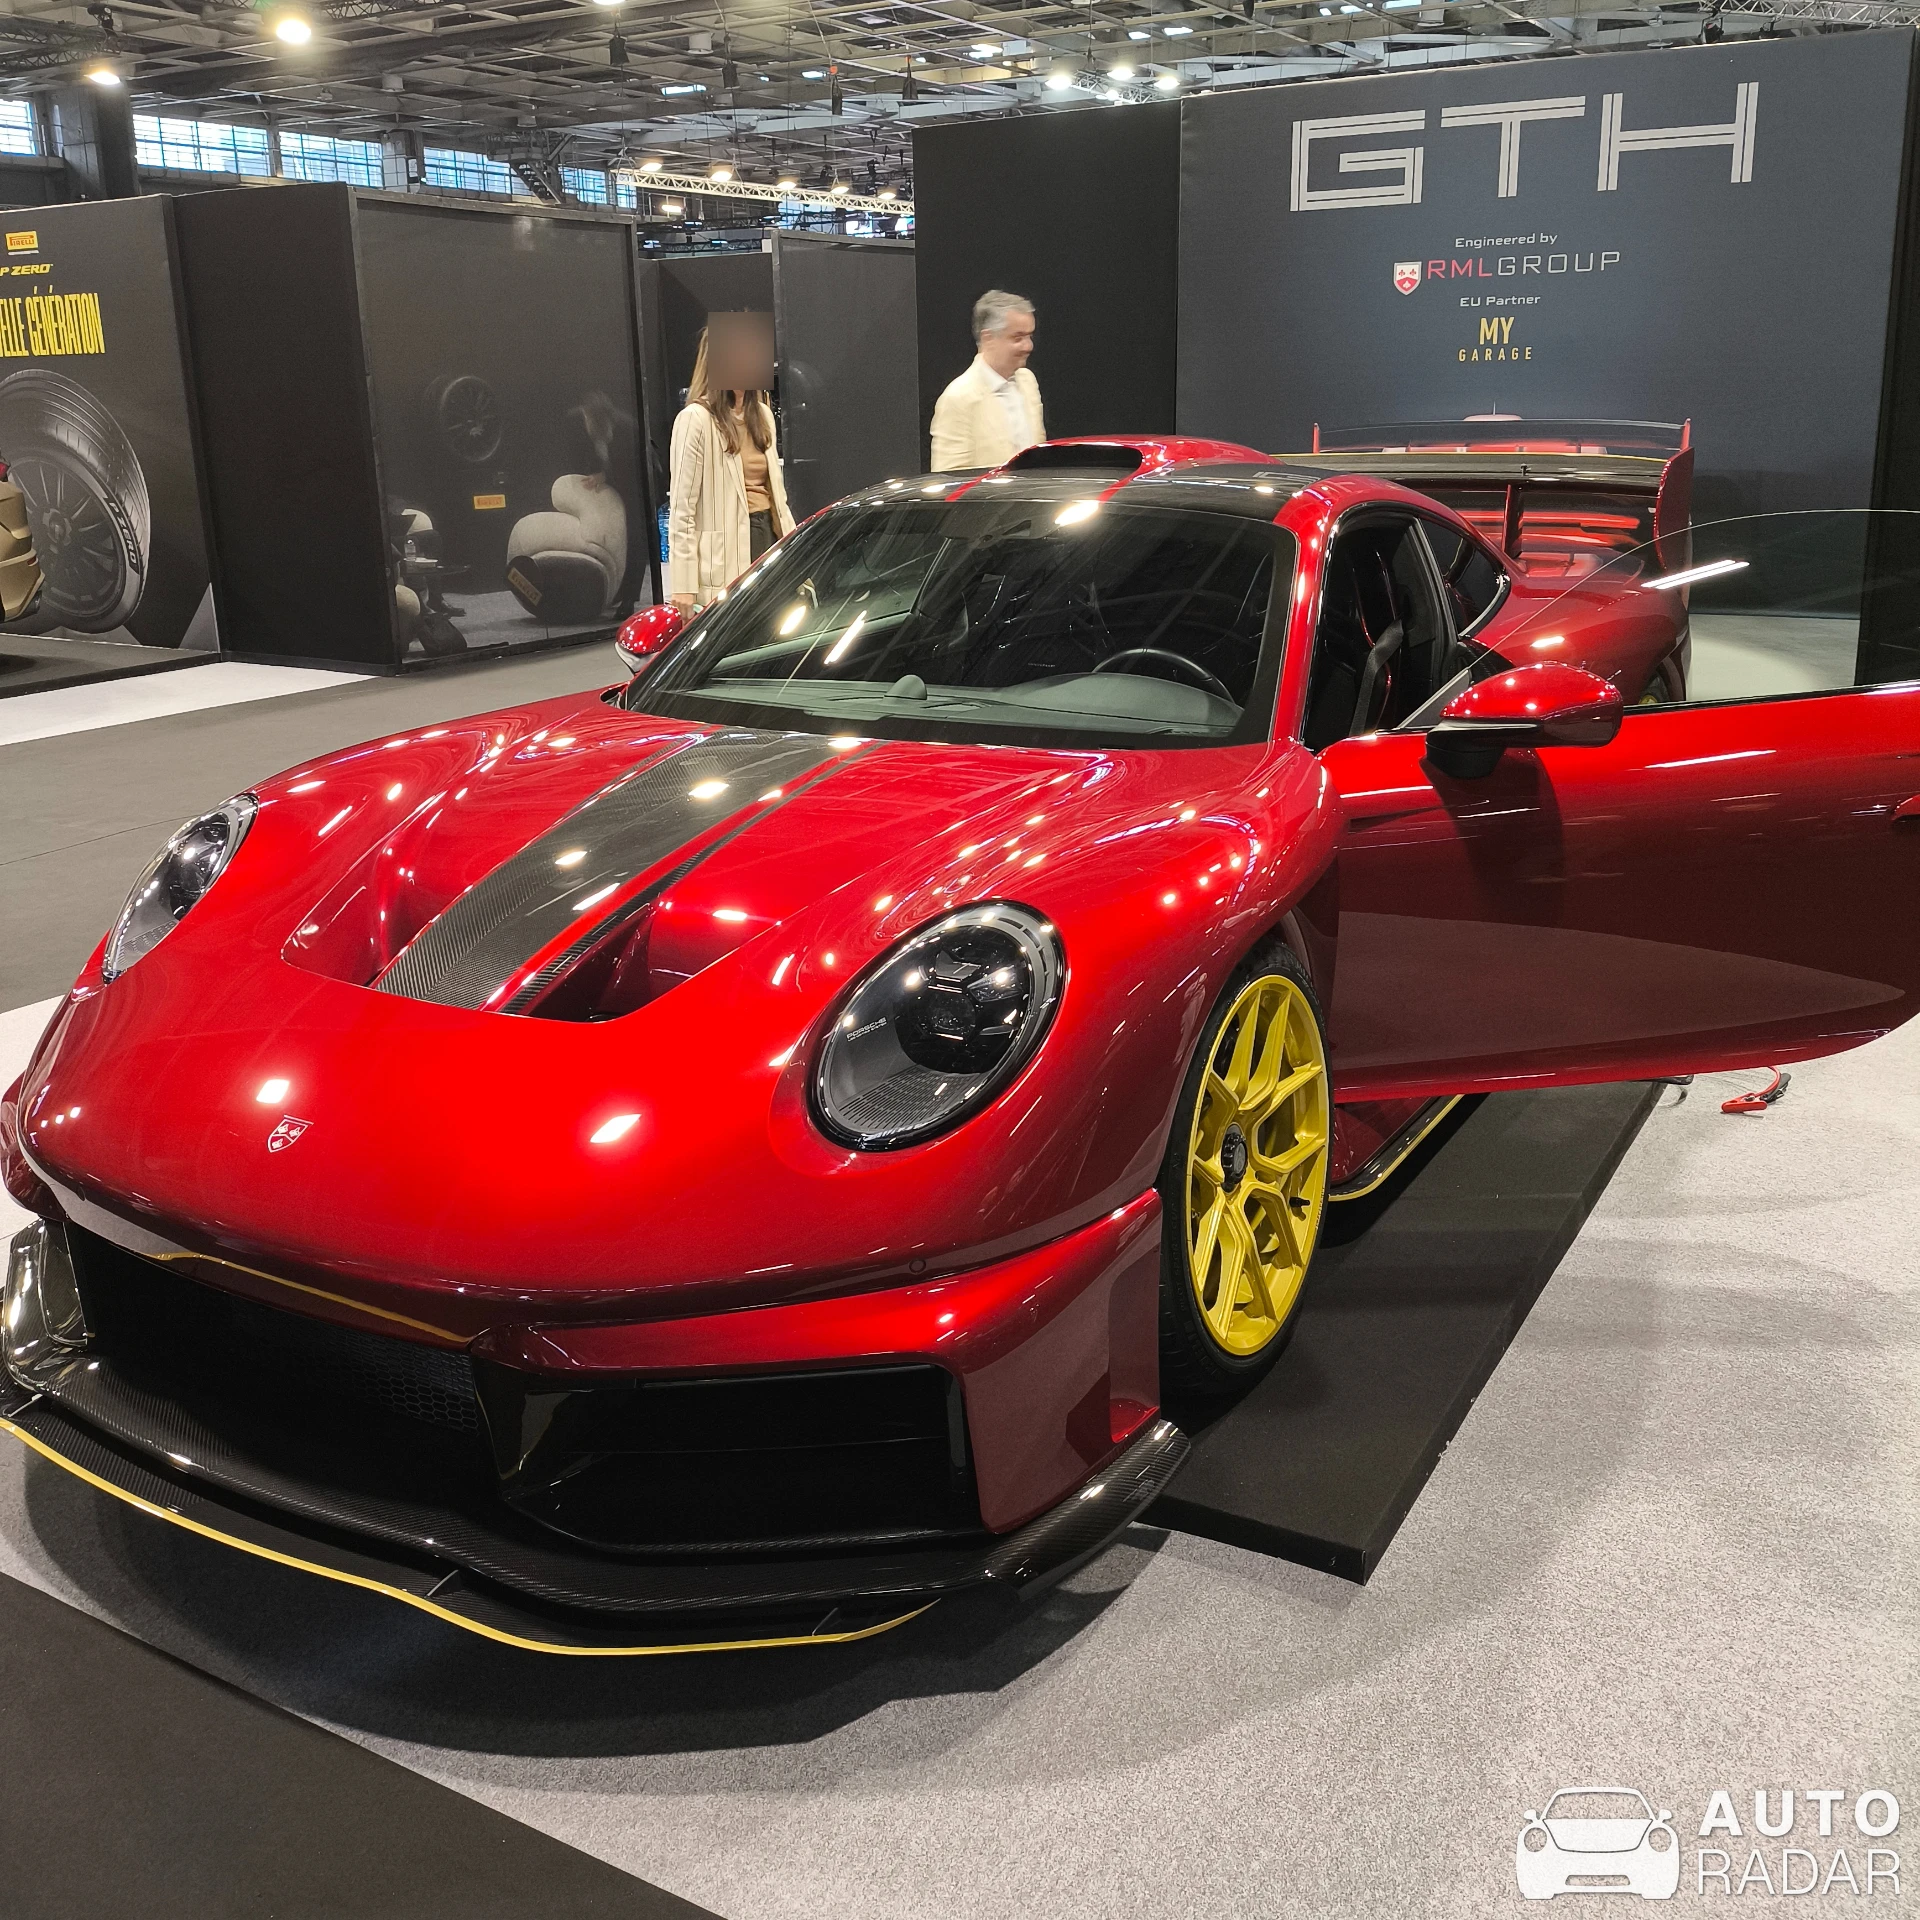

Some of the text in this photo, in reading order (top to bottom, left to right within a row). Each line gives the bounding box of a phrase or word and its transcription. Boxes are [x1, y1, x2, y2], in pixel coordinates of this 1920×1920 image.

[1290, 82, 1759, 211] GTH
[9, 235, 34, 246] PIRELLI
[1455, 232, 1558, 249] Engineered by
[0, 264, 51, 276] P ZERO
[1459, 294, 1541, 307] EU Partner
[0, 285, 105, 357] ELLE GÉNÉRATION
[1479, 316, 1515, 345] MY
[1458, 346, 1532, 362] GARAGE
[108, 502, 120, 513] P
